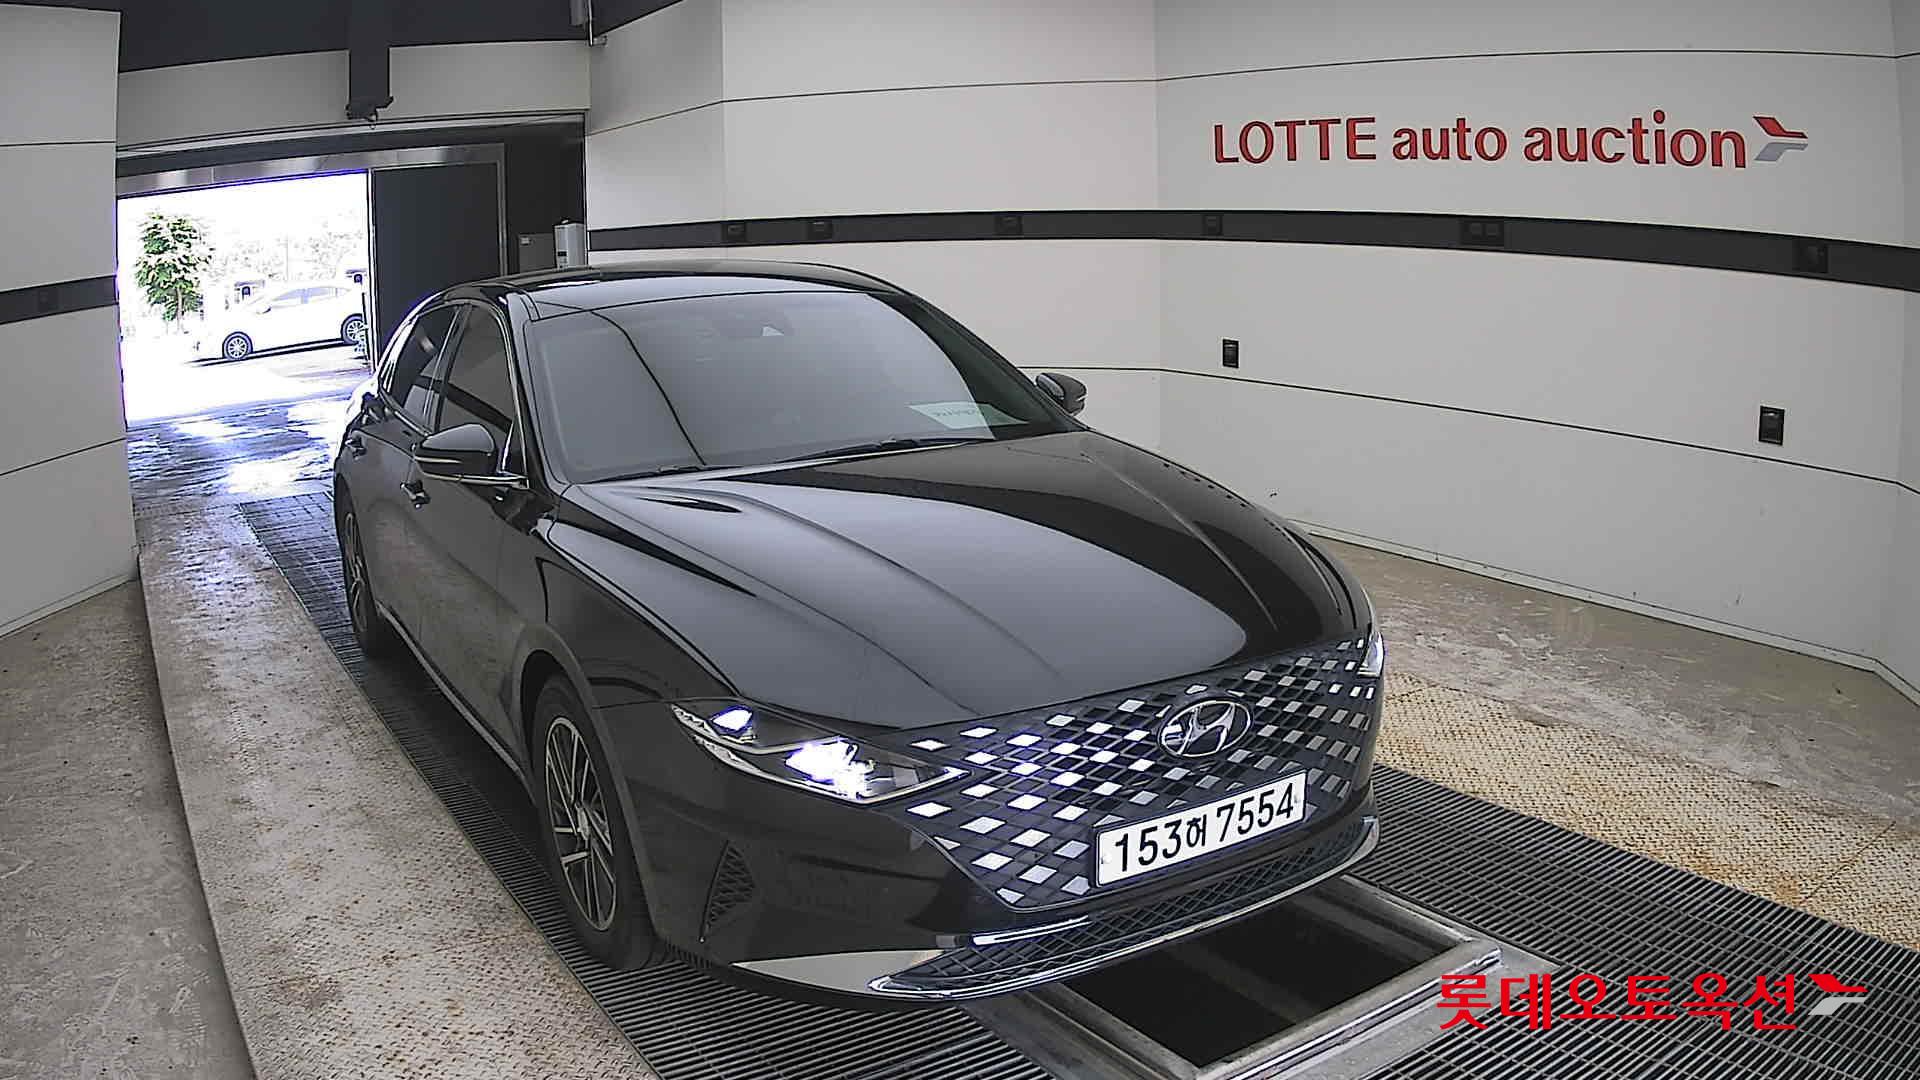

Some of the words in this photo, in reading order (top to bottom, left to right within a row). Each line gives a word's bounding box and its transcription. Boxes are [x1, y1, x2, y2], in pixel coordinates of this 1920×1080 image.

[1213, 116, 1377, 165] LOTTE
[1391, 117, 1508, 163] auto
[1522, 110, 1747, 169] auction
[1115, 814, 1207, 872] 153허
[1216, 783, 1294, 842] 7554
